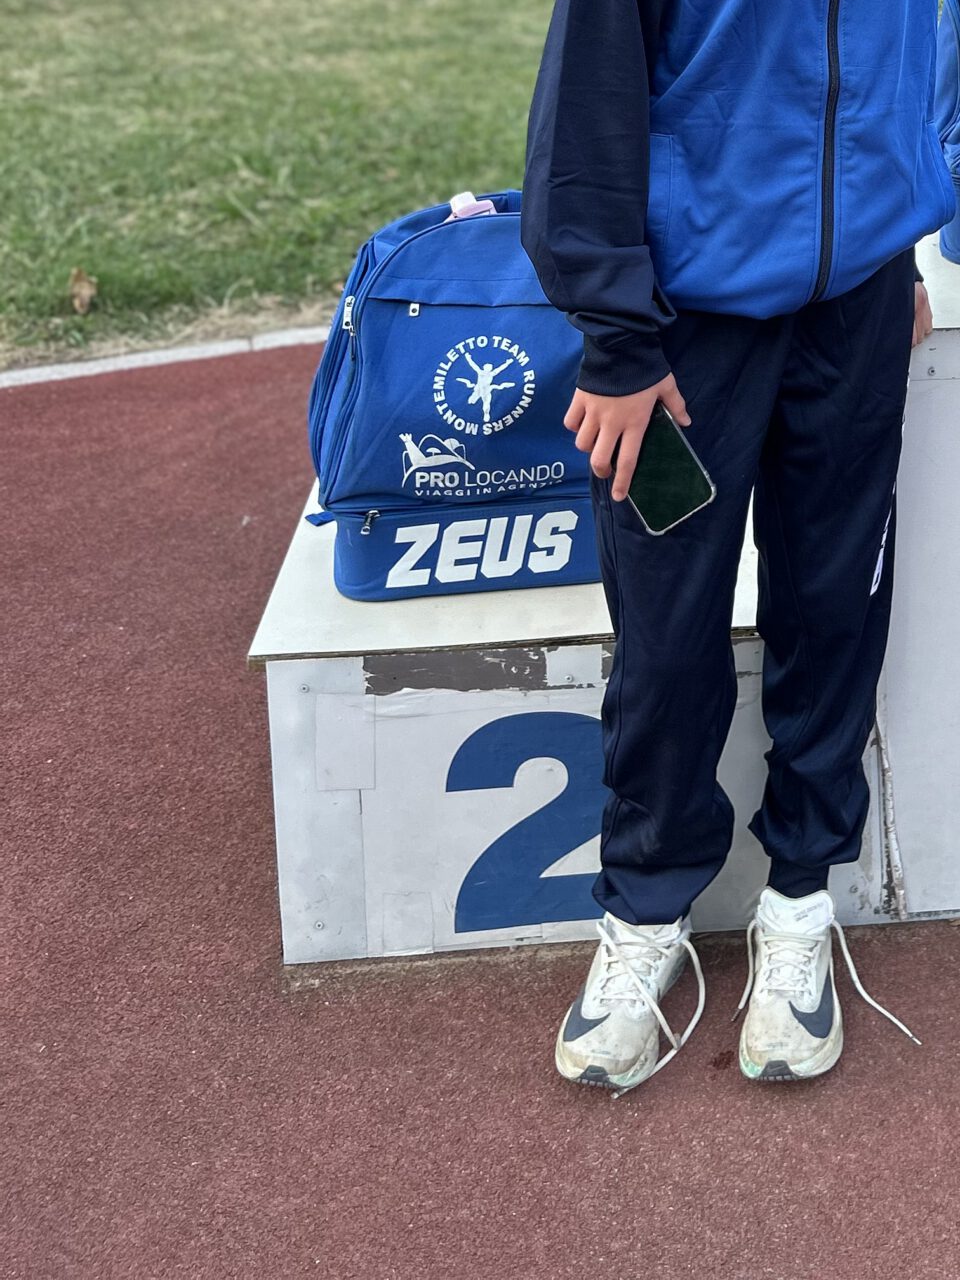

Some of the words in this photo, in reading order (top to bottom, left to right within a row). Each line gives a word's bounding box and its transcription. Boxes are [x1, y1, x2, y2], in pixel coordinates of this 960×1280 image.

[492, 335, 530, 366] TEAM
[433, 335, 488, 435] MONTEMILETTO
[482, 369, 536, 435] RUNNERS
[415, 471, 460, 488] PRO
[465, 461, 565, 487] LOCANDO
[476, 487, 492, 495] IN
[386, 510, 579, 588] ZEUS
[446, 711, 612, 933] 2
